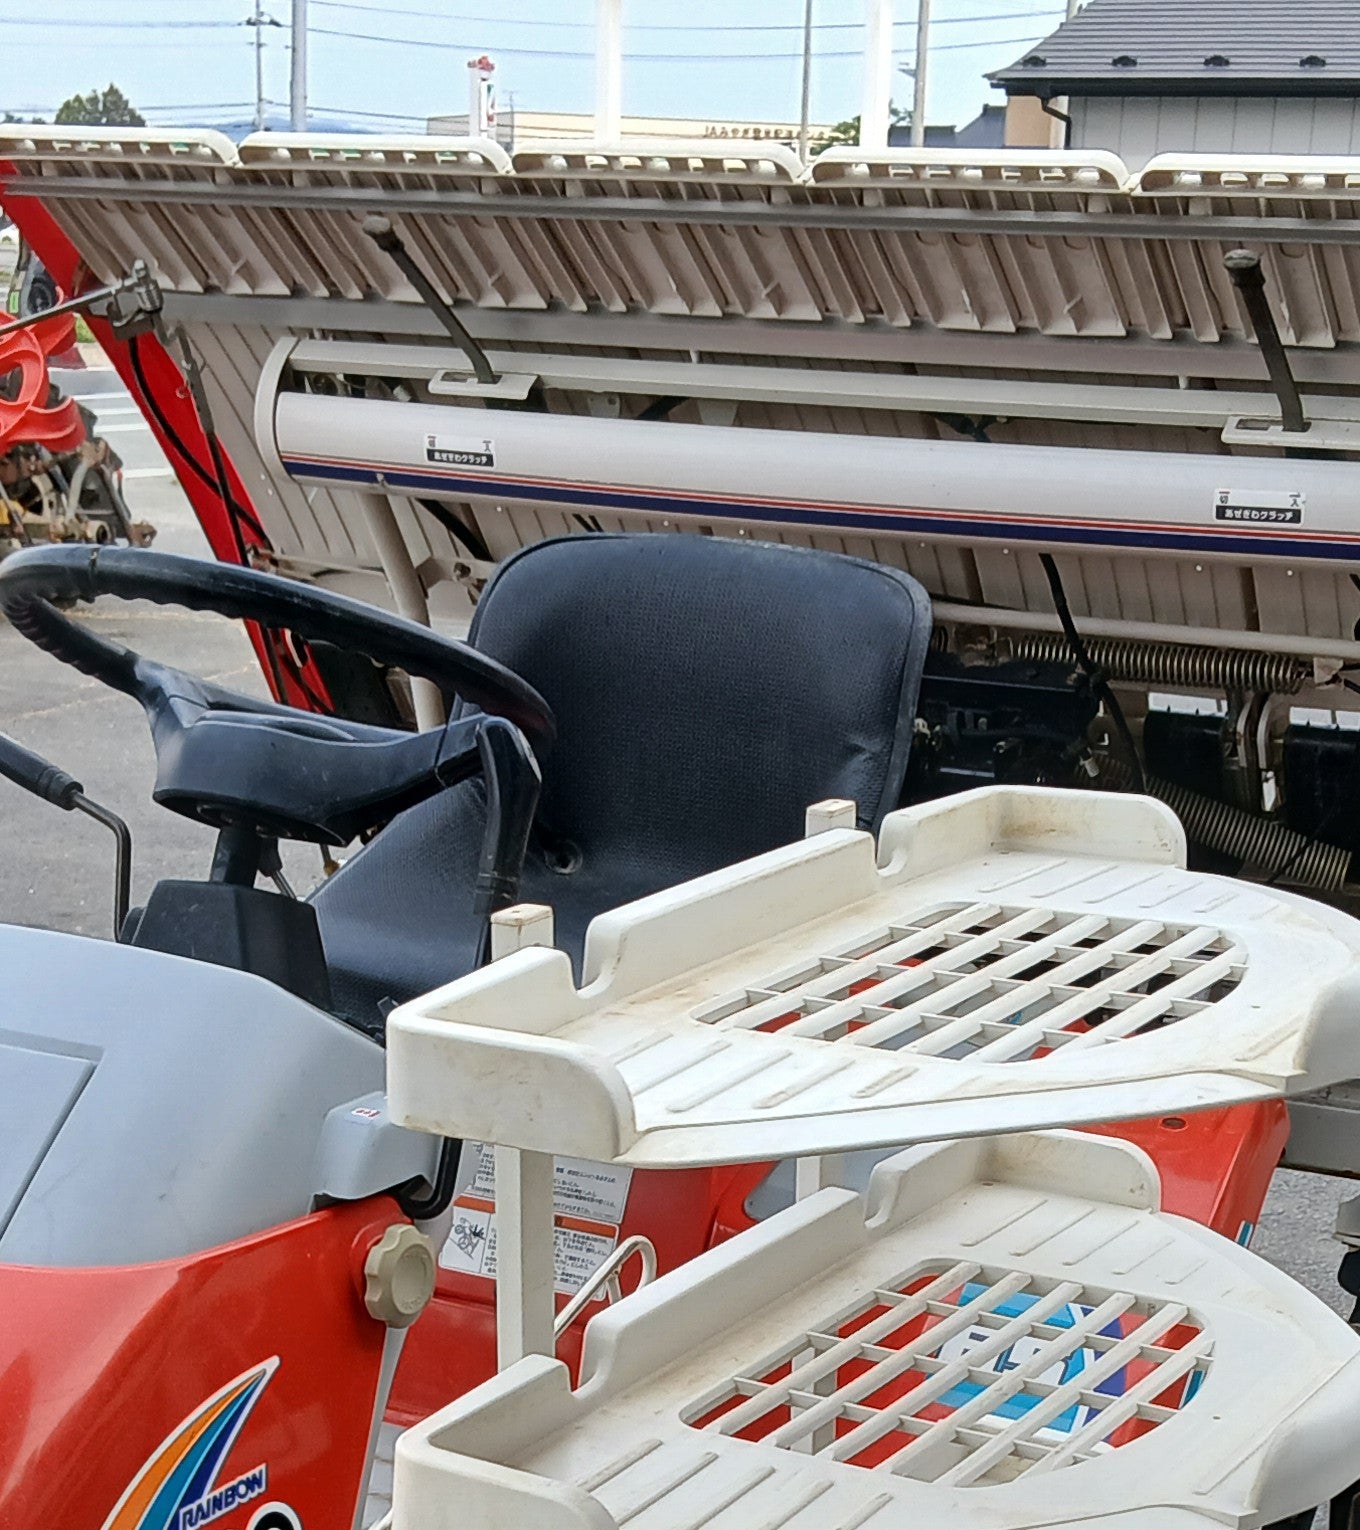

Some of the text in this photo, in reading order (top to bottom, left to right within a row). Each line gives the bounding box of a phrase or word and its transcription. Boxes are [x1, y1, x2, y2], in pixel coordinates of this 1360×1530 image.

[1224, 508, 1294, 521] あぜぎわクラッチ
